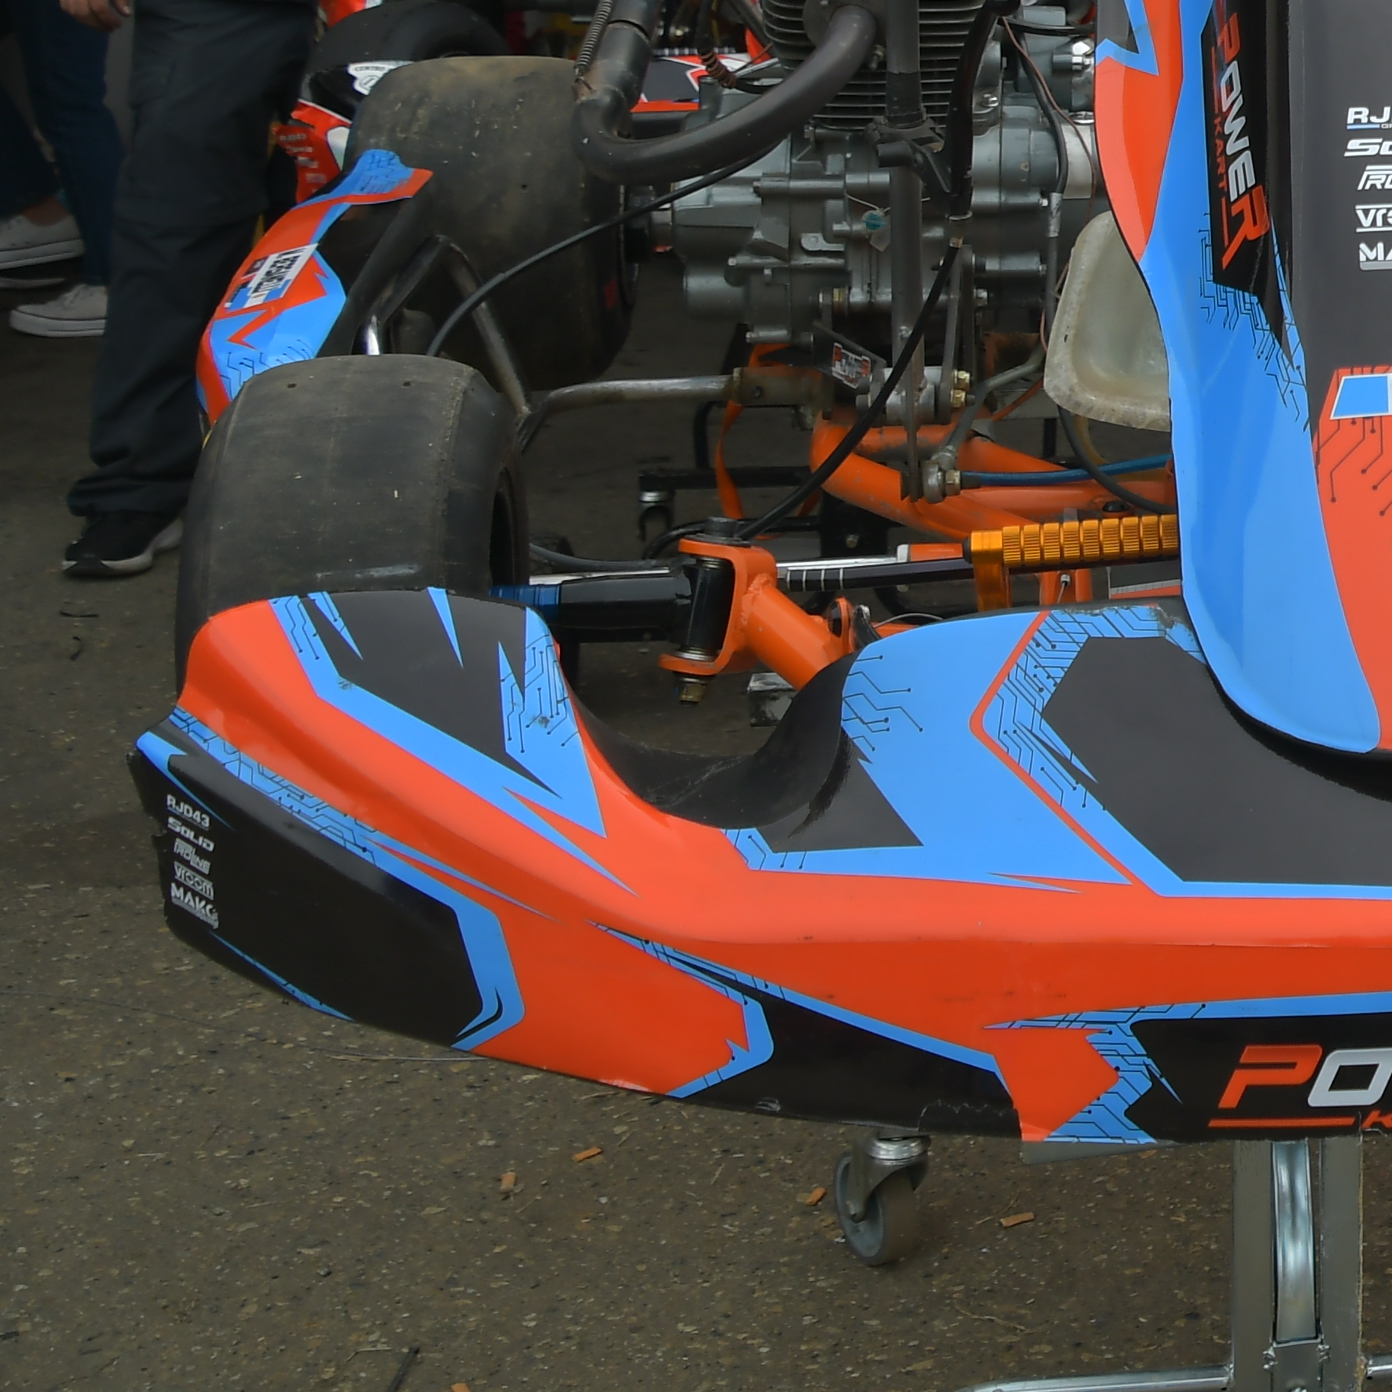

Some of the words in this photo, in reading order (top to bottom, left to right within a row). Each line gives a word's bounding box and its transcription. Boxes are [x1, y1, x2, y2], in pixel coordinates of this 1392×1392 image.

[1213, 118, 1228, 192] KART
[1217, 12, 1270, 268] POWER
[167, 794, 210, 828] RJD43
[167, 816, 214, 851] SOLID
